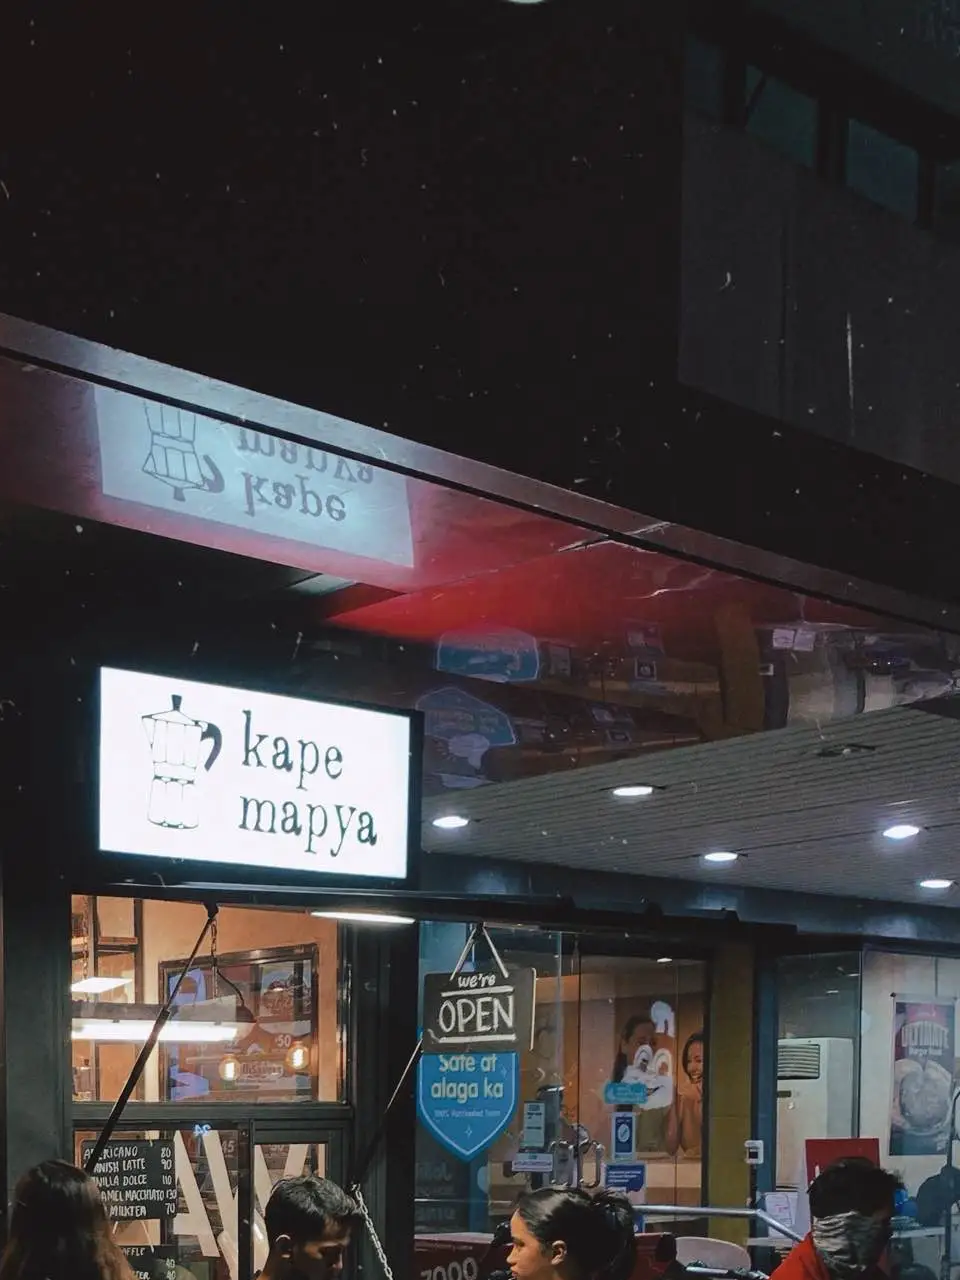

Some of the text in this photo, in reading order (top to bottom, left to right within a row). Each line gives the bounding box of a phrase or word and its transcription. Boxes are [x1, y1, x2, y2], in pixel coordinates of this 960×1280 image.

[241, 708, 344, 791] kape
[238, 795, 379, 857] mapya
[457, 973, 497, 988] we're
[438, 994, 515, 1032] OPEN
[431, 1076, 504, 1104] alaga ka
[83, 1145, 171, 1161] ARICANO 80
[88, 1157, 172, 1173] ANISH LATTE 90
[122, 1174, 147, 1187] DOLCE
[162, 1175, 172, 1185] 110
[100, 1188, 177, 1202] AMEL MACCHIATO 130
[109, 1203, 176, 1217] MILKTEA 70
[122, 1247, 146, 1257] AFFLE
